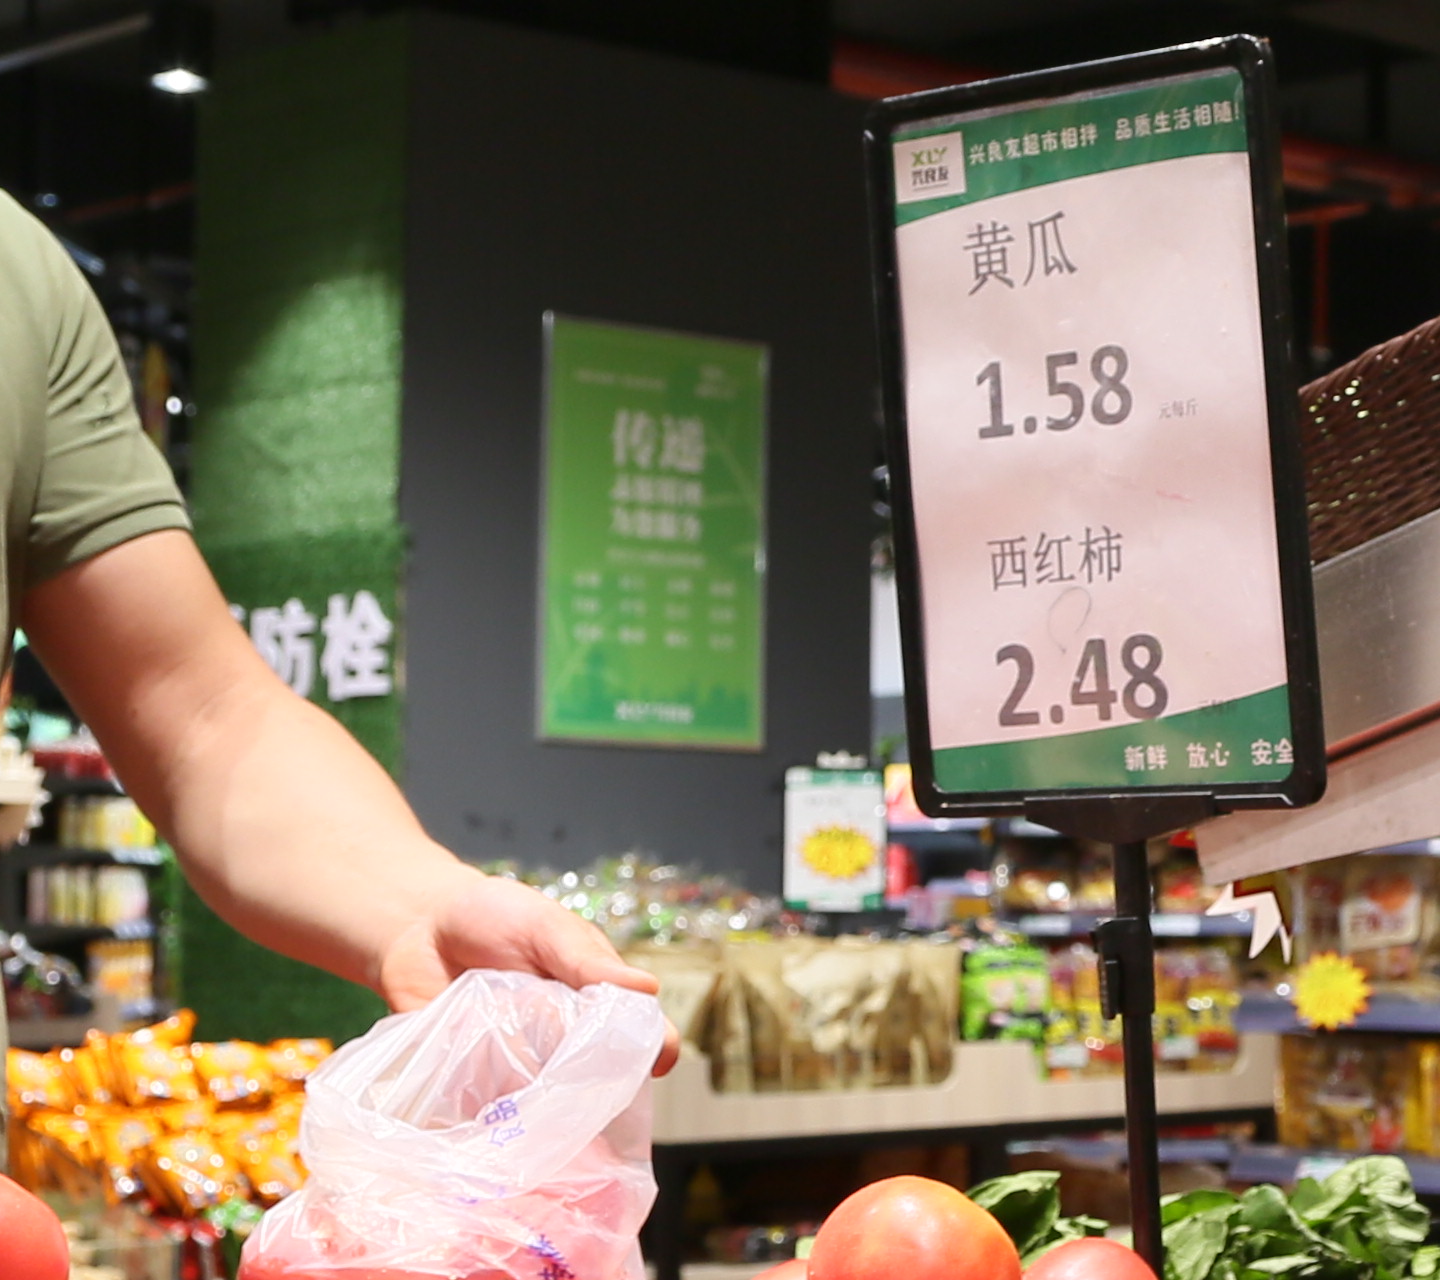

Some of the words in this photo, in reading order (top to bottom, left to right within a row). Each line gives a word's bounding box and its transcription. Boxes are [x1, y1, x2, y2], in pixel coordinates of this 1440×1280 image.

[963, 210, 1078, 296] 黄瓜
[975, 344, 1133, 440] 1.58
[986, 524, 1123, 592] 西红柿
[229, 589, 394, 703] 防栓
[995, 633, 1169, 728] 2.48
[1124, 743, 1168, 771] 新鲜
[1186, 741, 1231, 769] 放心
[1251, 737, 1295, 766] 安全
